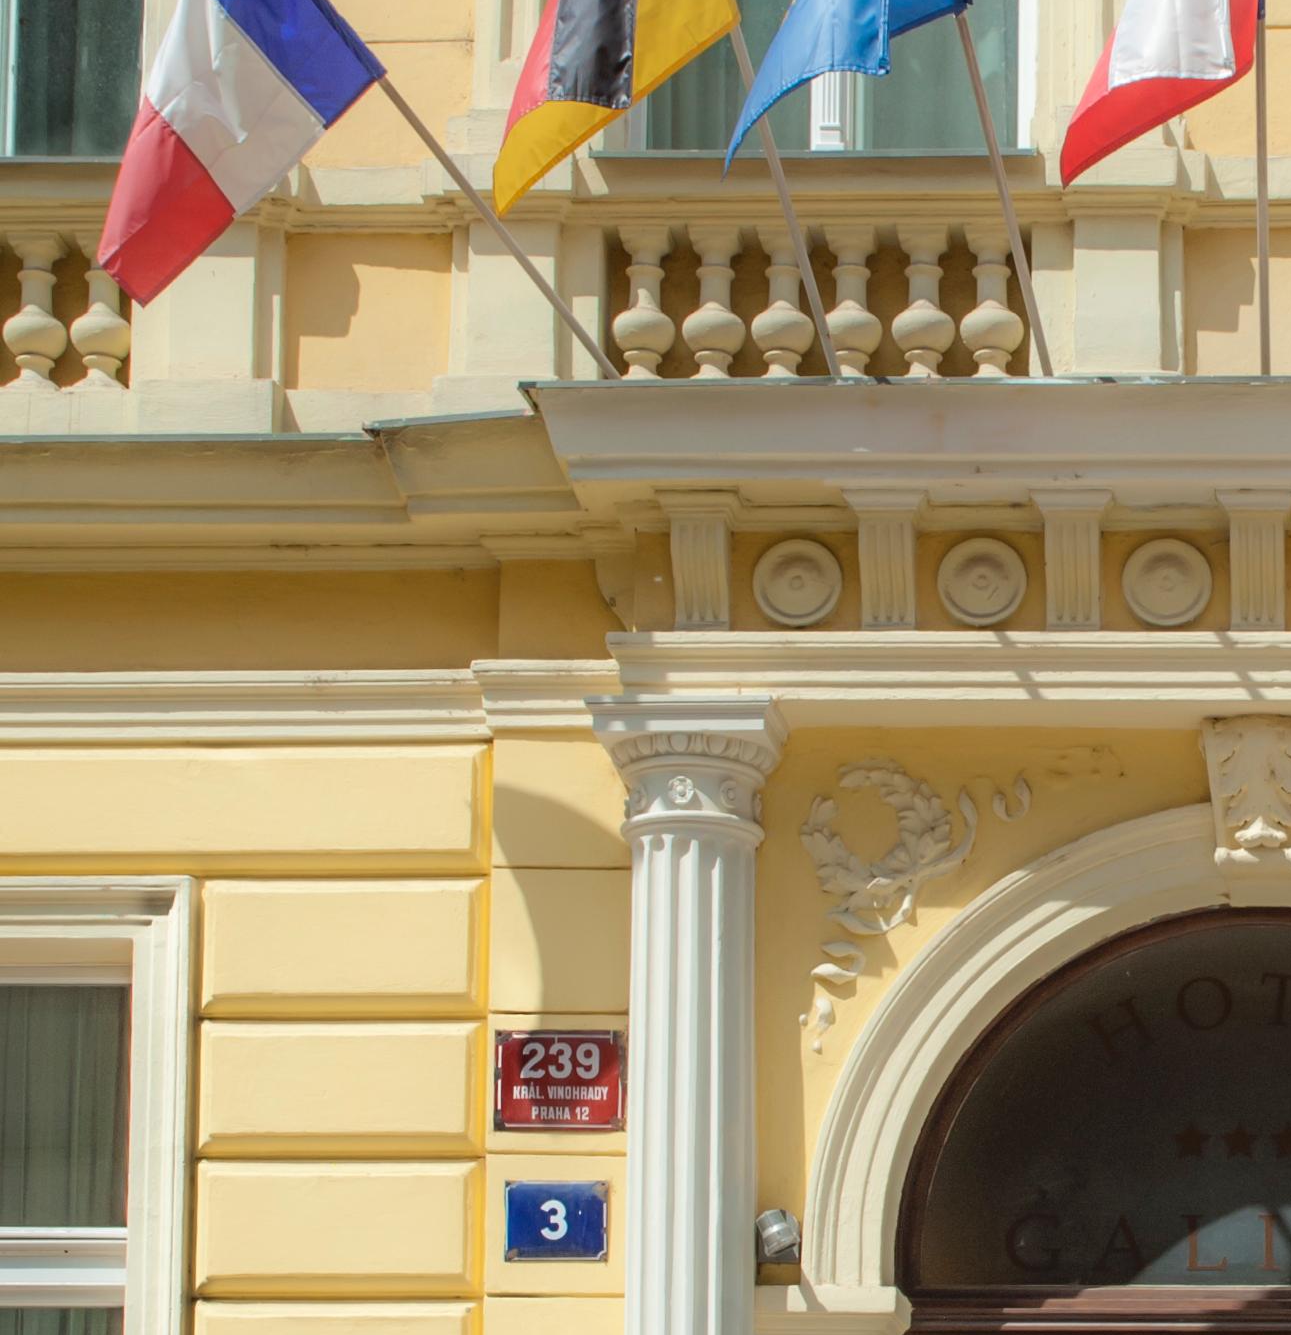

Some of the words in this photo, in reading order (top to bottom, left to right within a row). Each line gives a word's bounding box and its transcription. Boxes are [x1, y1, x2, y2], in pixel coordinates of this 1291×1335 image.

[520, 1042, 600, 1079] 239
[513, 1082, 544, 1100] KRÁL.
[547, 1085, 608, 1100] VINOHRADY
[531, 1106, 571, 1120] PRAHA
[575, 1106, 590, 1120] 12
[540, 1199, 568, 1240] 3
